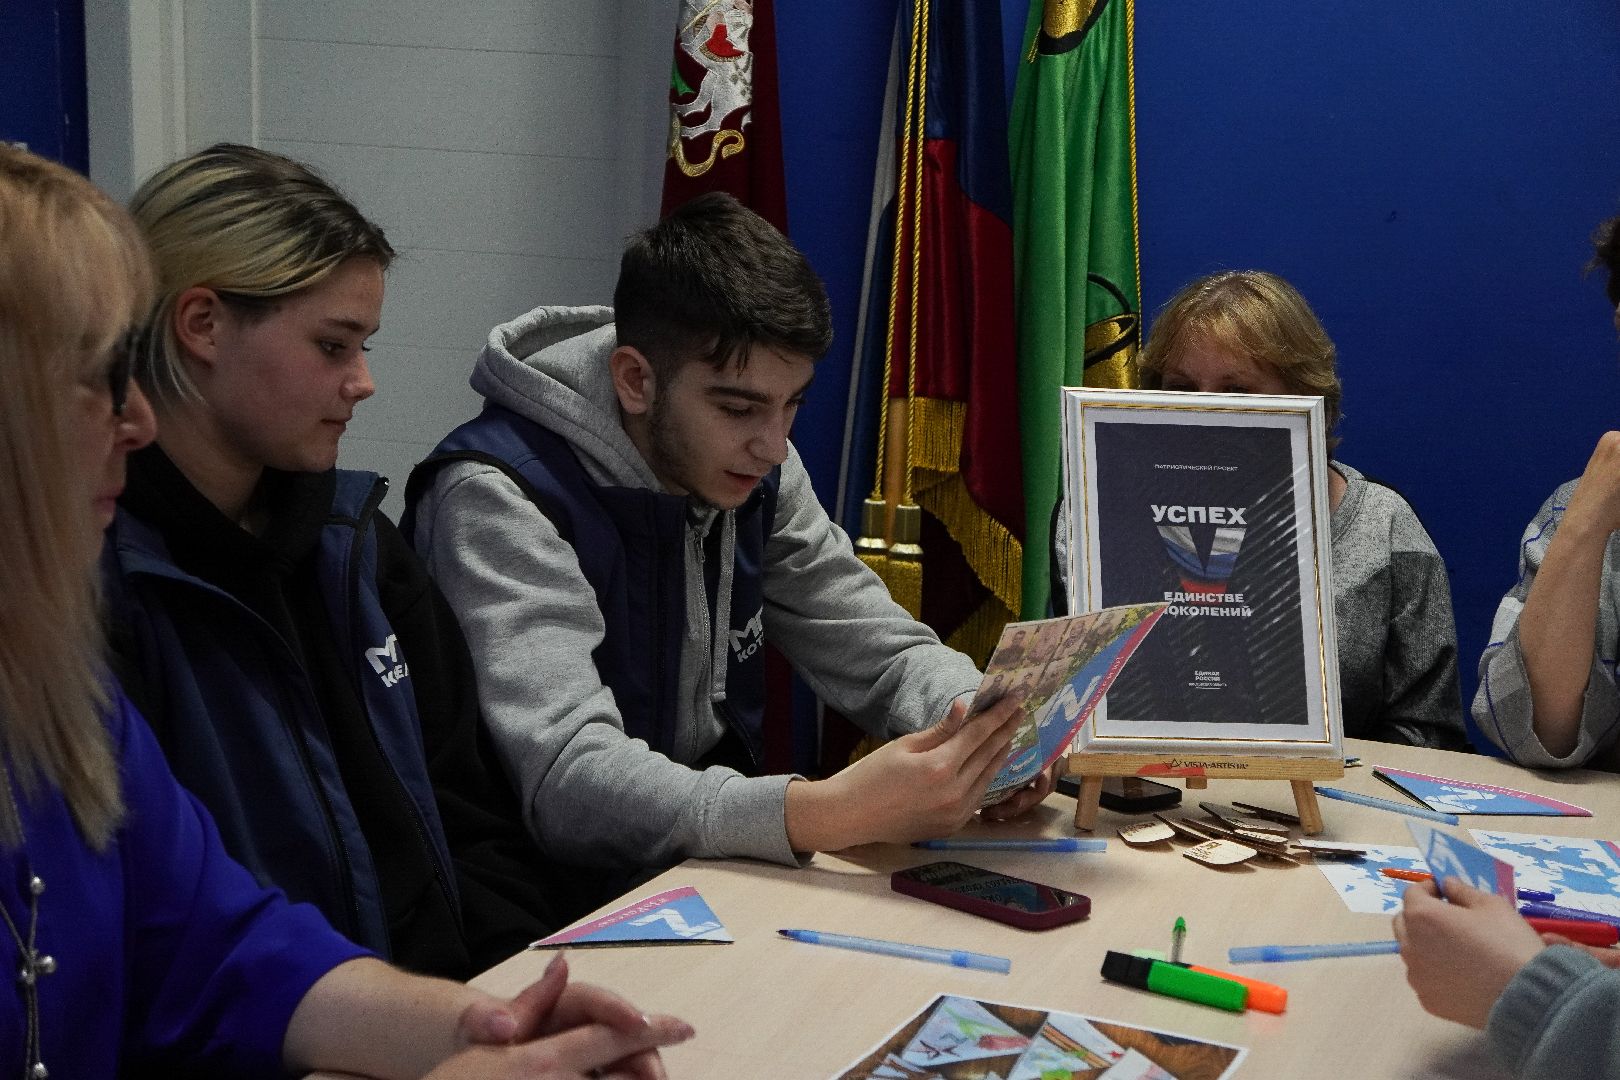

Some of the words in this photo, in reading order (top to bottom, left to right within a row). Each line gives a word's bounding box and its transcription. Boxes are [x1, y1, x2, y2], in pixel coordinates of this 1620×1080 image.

[1150, 504, 1248, 525] УСПЕХ
[1164, 591, 1244, 603] ЕДИНСТВЕ
[736, 631, 765, 663] КОТ
